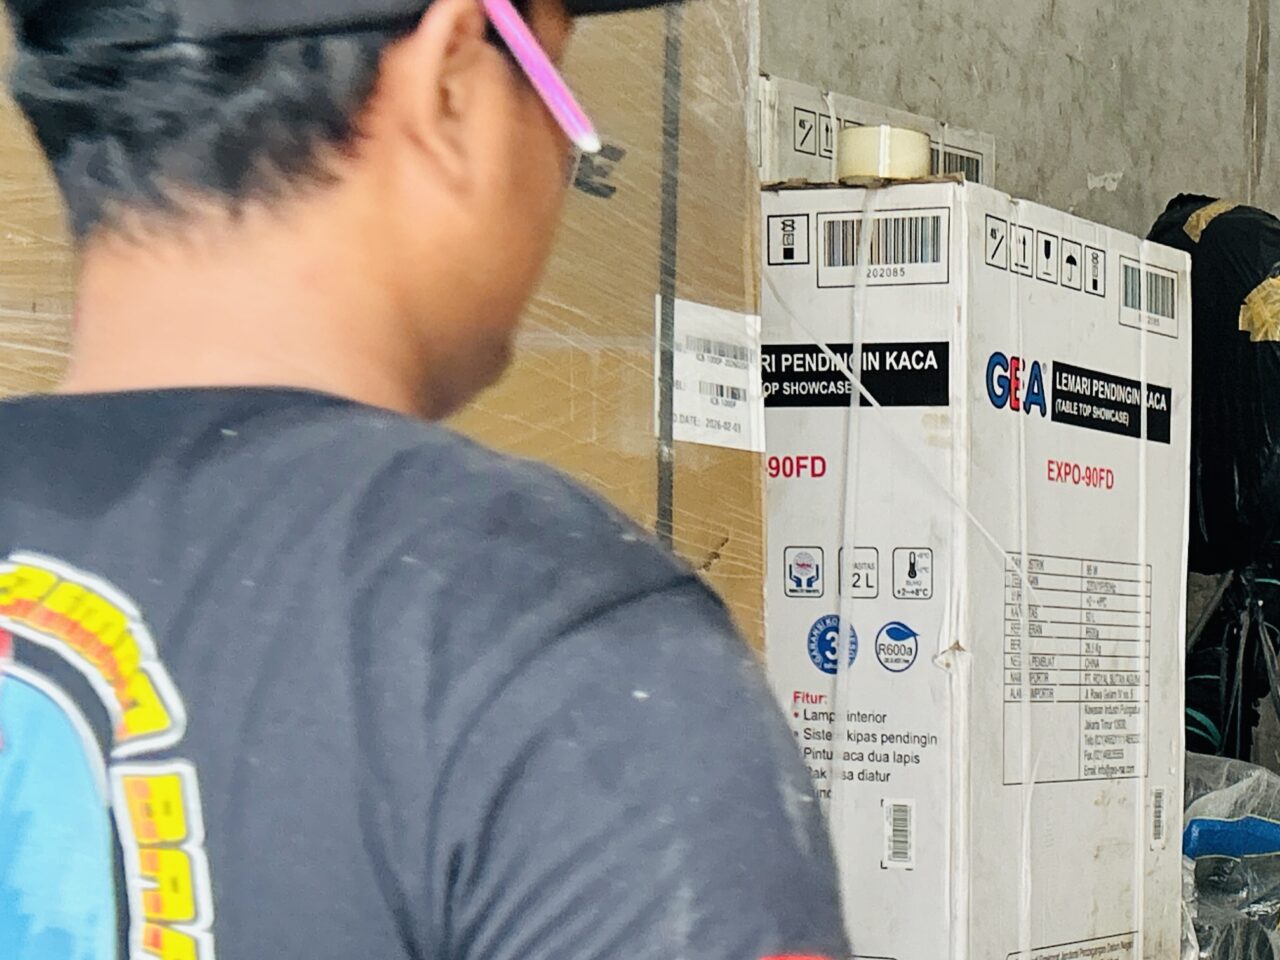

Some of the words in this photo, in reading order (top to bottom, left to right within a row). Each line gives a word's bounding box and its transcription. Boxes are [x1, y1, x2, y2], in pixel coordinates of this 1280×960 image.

[866, 268, 906, 278] 202085
[761, 354, 776, 373] RI
[885, 350, 938, 371] KACA
[762, 382, 780, 395] OP
[985, 351, 1048, 418] GEA
[1055, 371, 1091, 396] LEMARI
[1092, 380, 1141, 406] PENDINGIN
[1055, 398, 1078, 416] (TABLE
[1079, 403, 1092, 417] TOP
[1092, 406, 1130, 427] SHOWCASE)
[767, 455, 827, 478] 90FD
[1047, 459, 1115, 490] EXPO-90FD
[851, 572, 861, 588] 2
[865, 572, 875, 588] L
[878, 643, 913, 656] R600a
[792, 691, 828, 704] Fitur:
[803, 708, 836, 723] Lamp
[846, 711, 887, 723] interior
[803, 728, 833, 741] Siste
[846, 730, 878, 744] kipas
[880, 732, 938, 748] pendingin
[802, 747, 833, 760] Pintu
[842, 751, 864, 762] aca
[867, 751, 890, 763] dua
[893, 751, 921, 766] lapis
[857, 769, 891, 782] diatur
